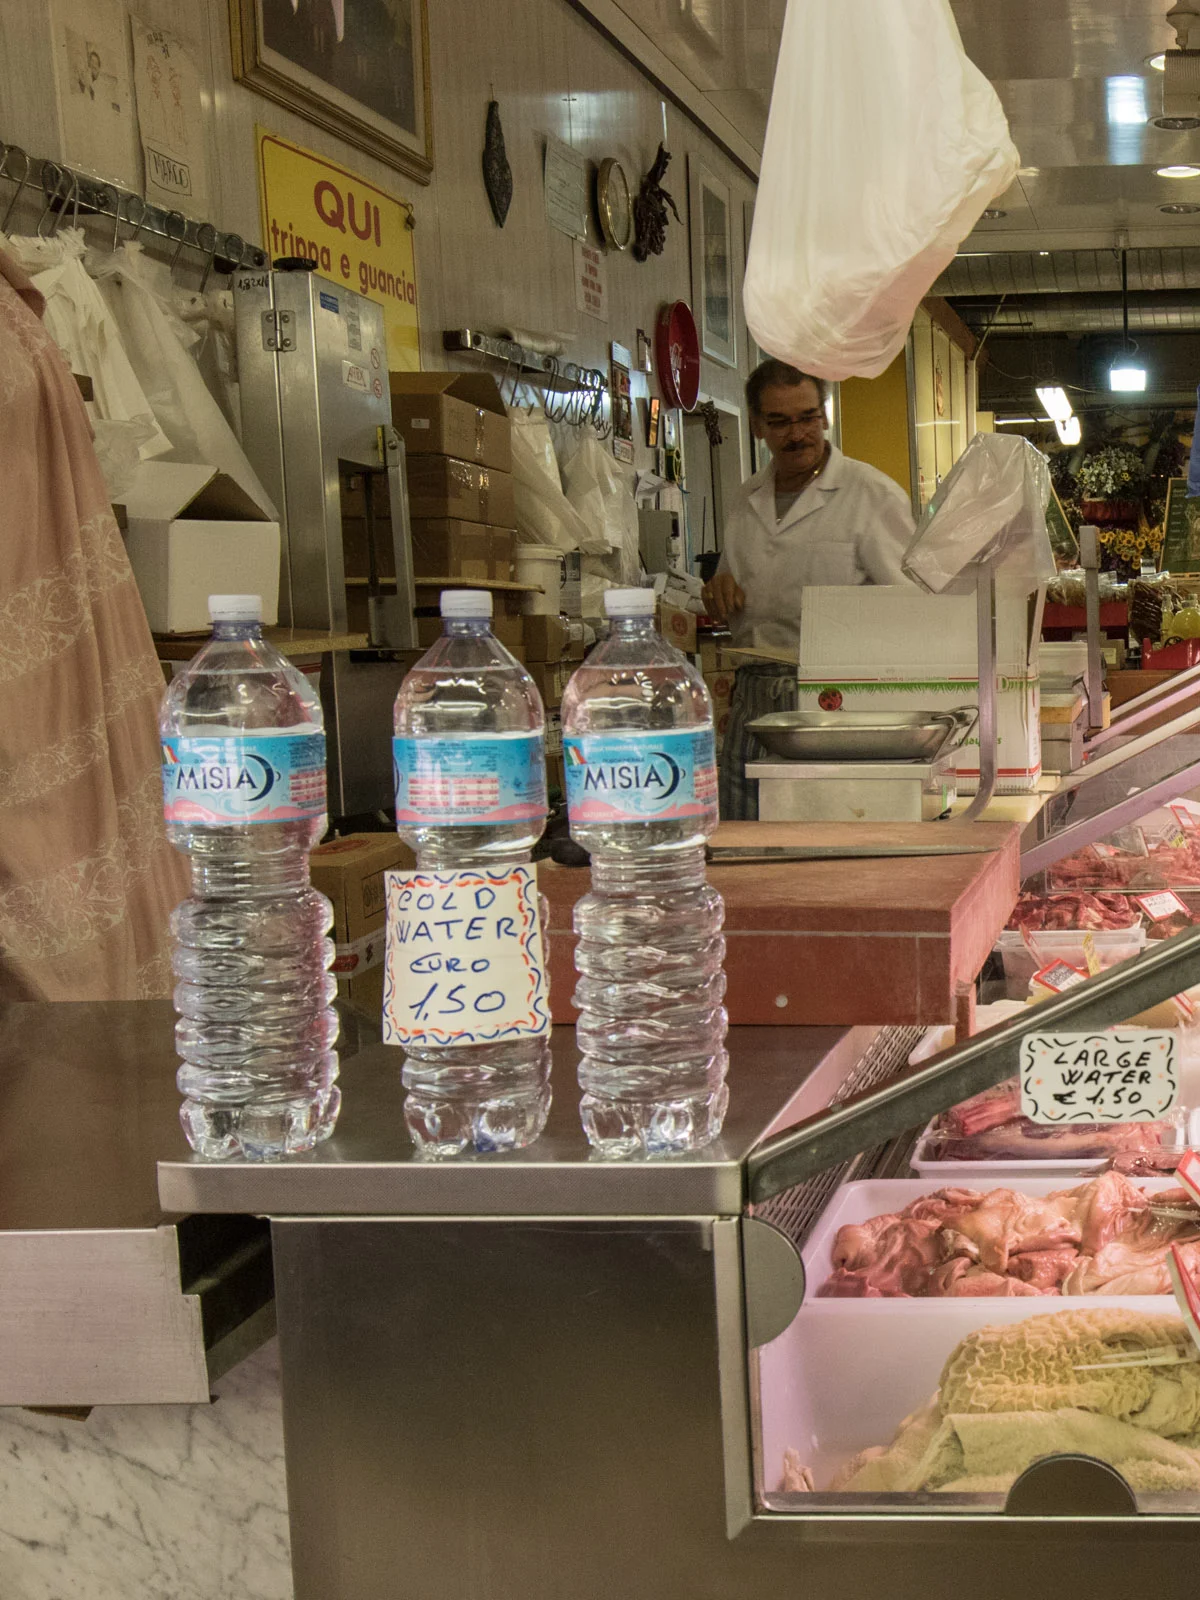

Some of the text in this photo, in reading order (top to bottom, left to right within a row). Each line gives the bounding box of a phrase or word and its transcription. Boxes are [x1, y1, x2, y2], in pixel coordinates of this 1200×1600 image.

[313, 179, 382, 248] QUI
[271, 218, 332, 273] trippa
[340, 253, 351, 280] e
[358, 257, 416, 305] guancia
[176, 765, 258, 790] MISIA
[584, 763, 665, 791] MISIA
[398, 887, 496, 911] COLD
[395, 916, 518, 943] WATER
[409, 952, 490, 974] EURO
[409, 983, 506, 1021] 1,50
[1053, 1049, 1152, 1068] LARGE
[1061, 1069, 1152, 1086] WATER
[1053, 1087, 1142, 1105] € 1,50
